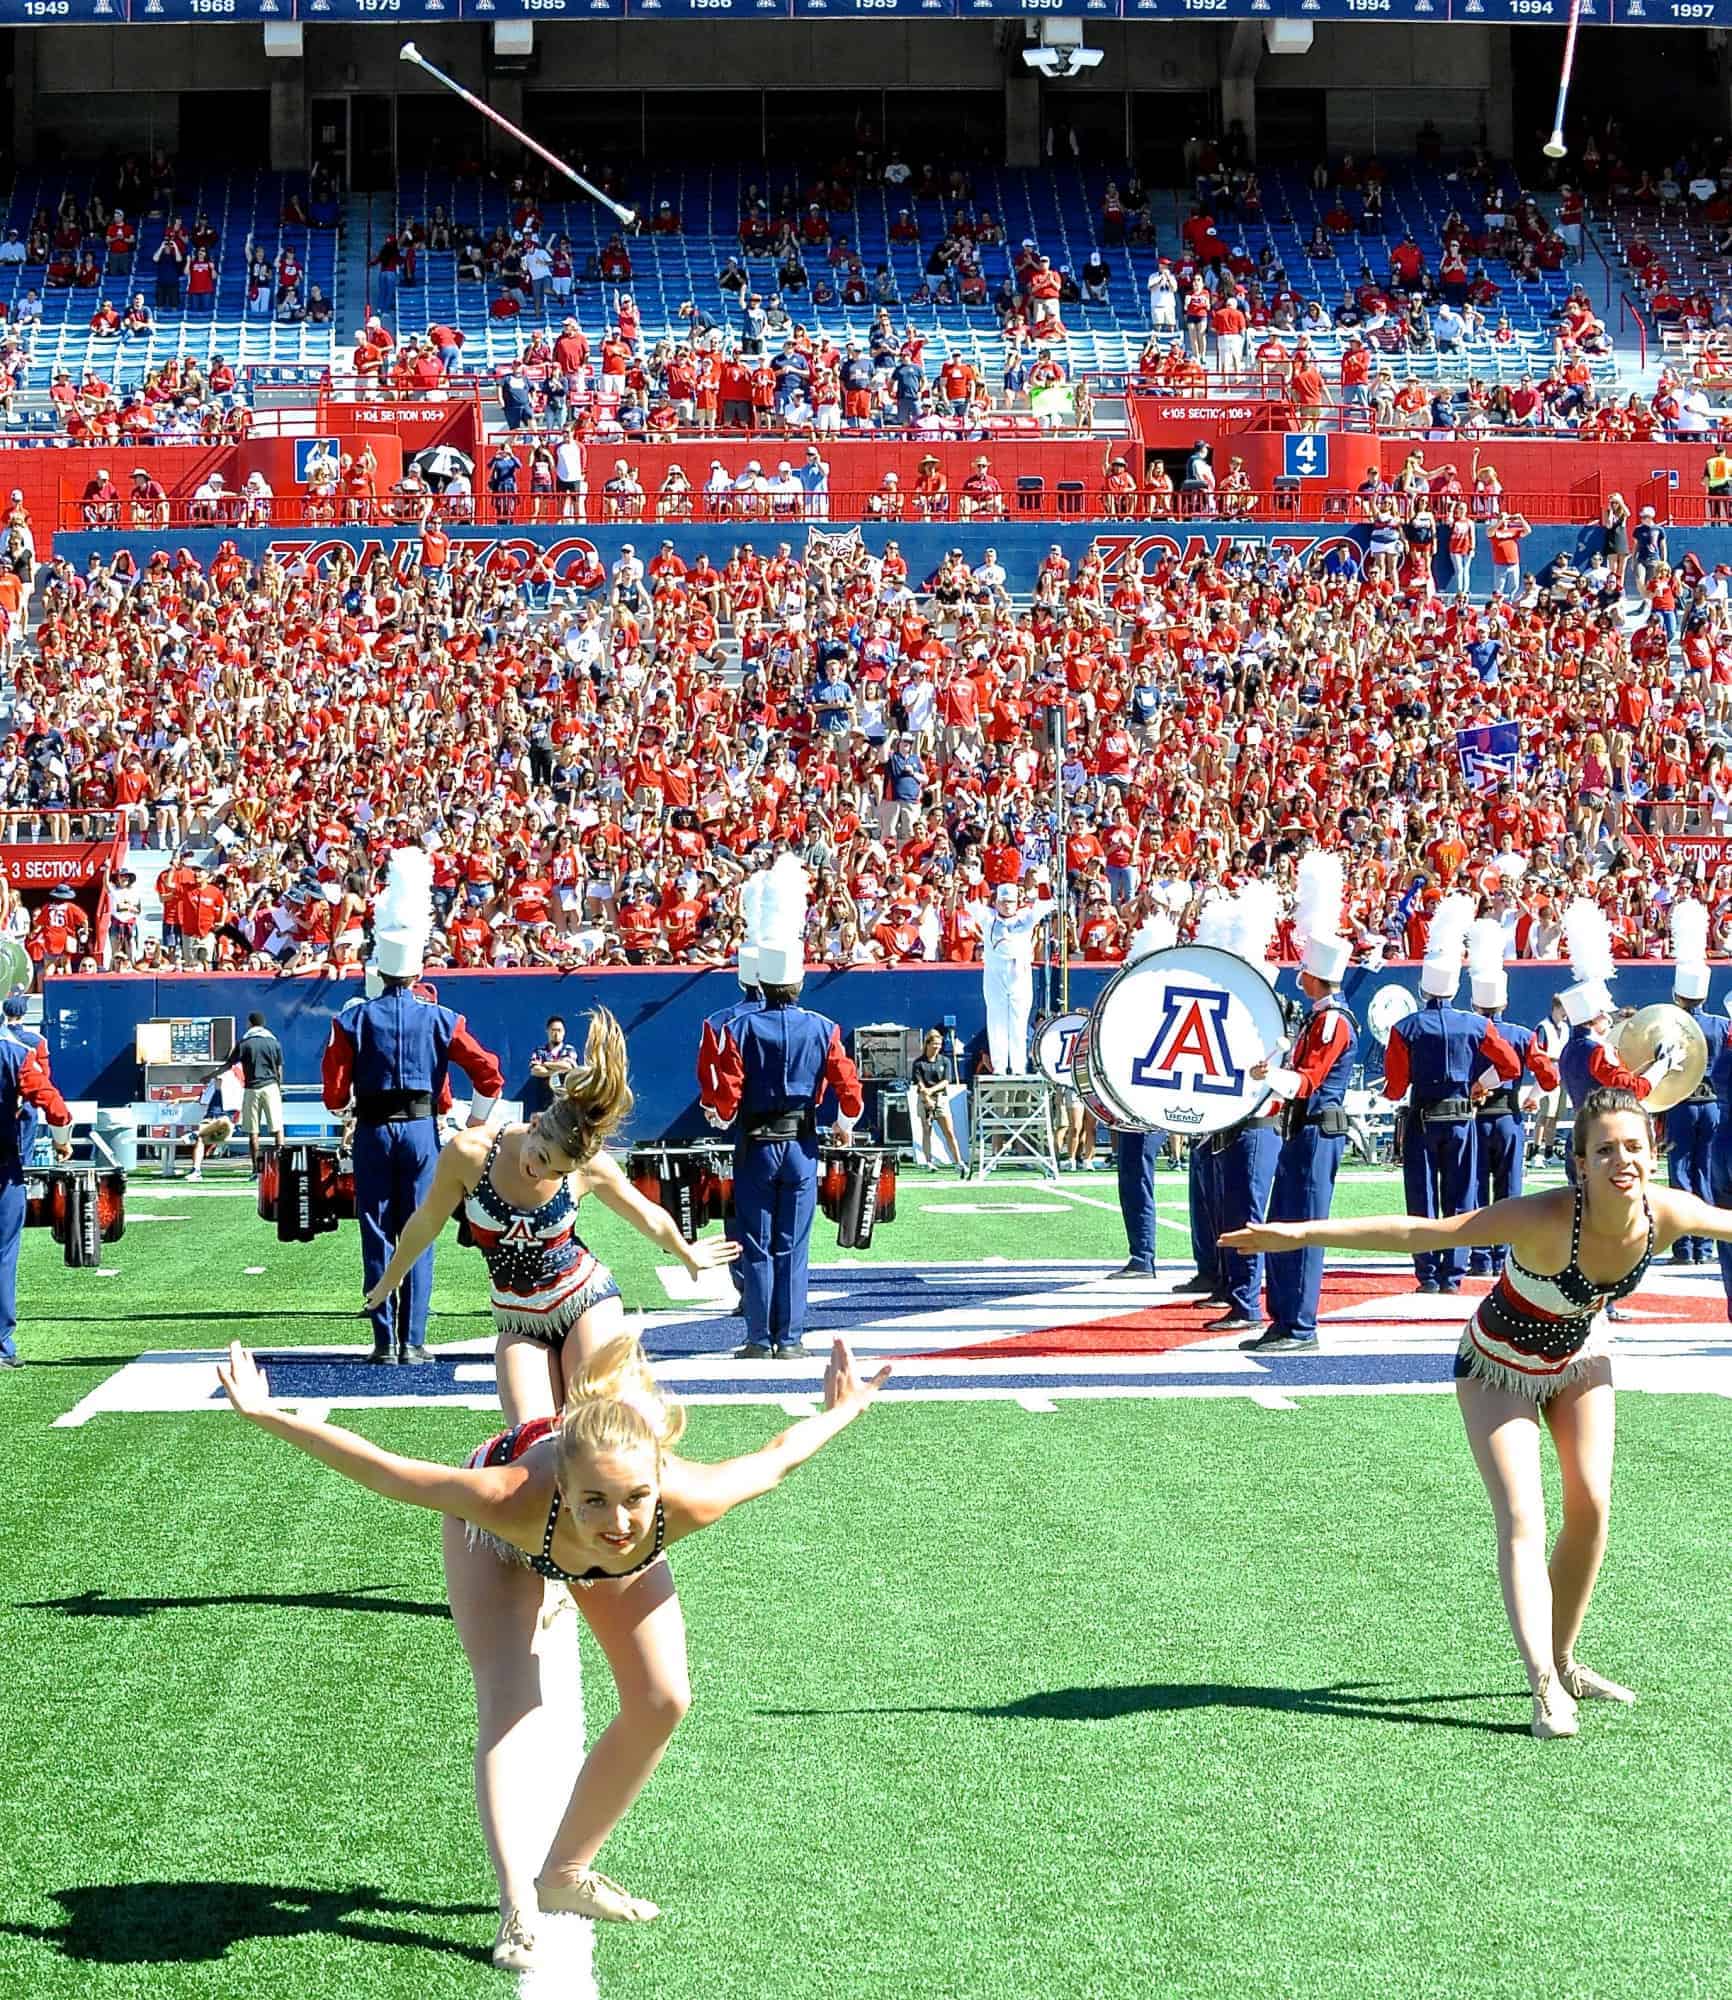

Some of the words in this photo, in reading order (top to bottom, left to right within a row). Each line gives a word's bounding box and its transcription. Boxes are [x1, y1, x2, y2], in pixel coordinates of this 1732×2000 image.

[24, 1, 70, 15] 1949
[190, 0, 235, 13] 1968
[355, 0, 401, 11] 1979
[521, 0, 566, 9] 1985
[689, 0, 732, 8] 1986
[855, 0, 897, 8] 1989
[1020, 0, 1063, 8] 1990
[1183, 0, 1227, 9] 1992
[1346, 0, 1391, 11] 1994
[1509, 1, 1554, 14] 1994
[1670, 4, 1714, 18] 1997
[1171, 408, 1185, 418] 105
[1229, 408, 1243, 419] 106
[1296, 436, 1317, 461] 4
[268, 539, 454, 591] ZON
[1679, 844, 1721, 861] CTION
[12, 862, 21, 878] 3
[25, 861, 82, 878] SECTION
[86, 860, 95, 877] 4
[49, 910, 65, 926] 16
[1131, 985, 1245, 1097] A
[680, 1186, 691, 1205] VIC
[866, 1184, 877, 1203] VIC
[83, 1201, 95, 1219] VIC
[860, 1204, 875, 1237] FIRTH
[84, 1221, 96, 1255] FIRTH
[499, 1215, 544, 1247] A
